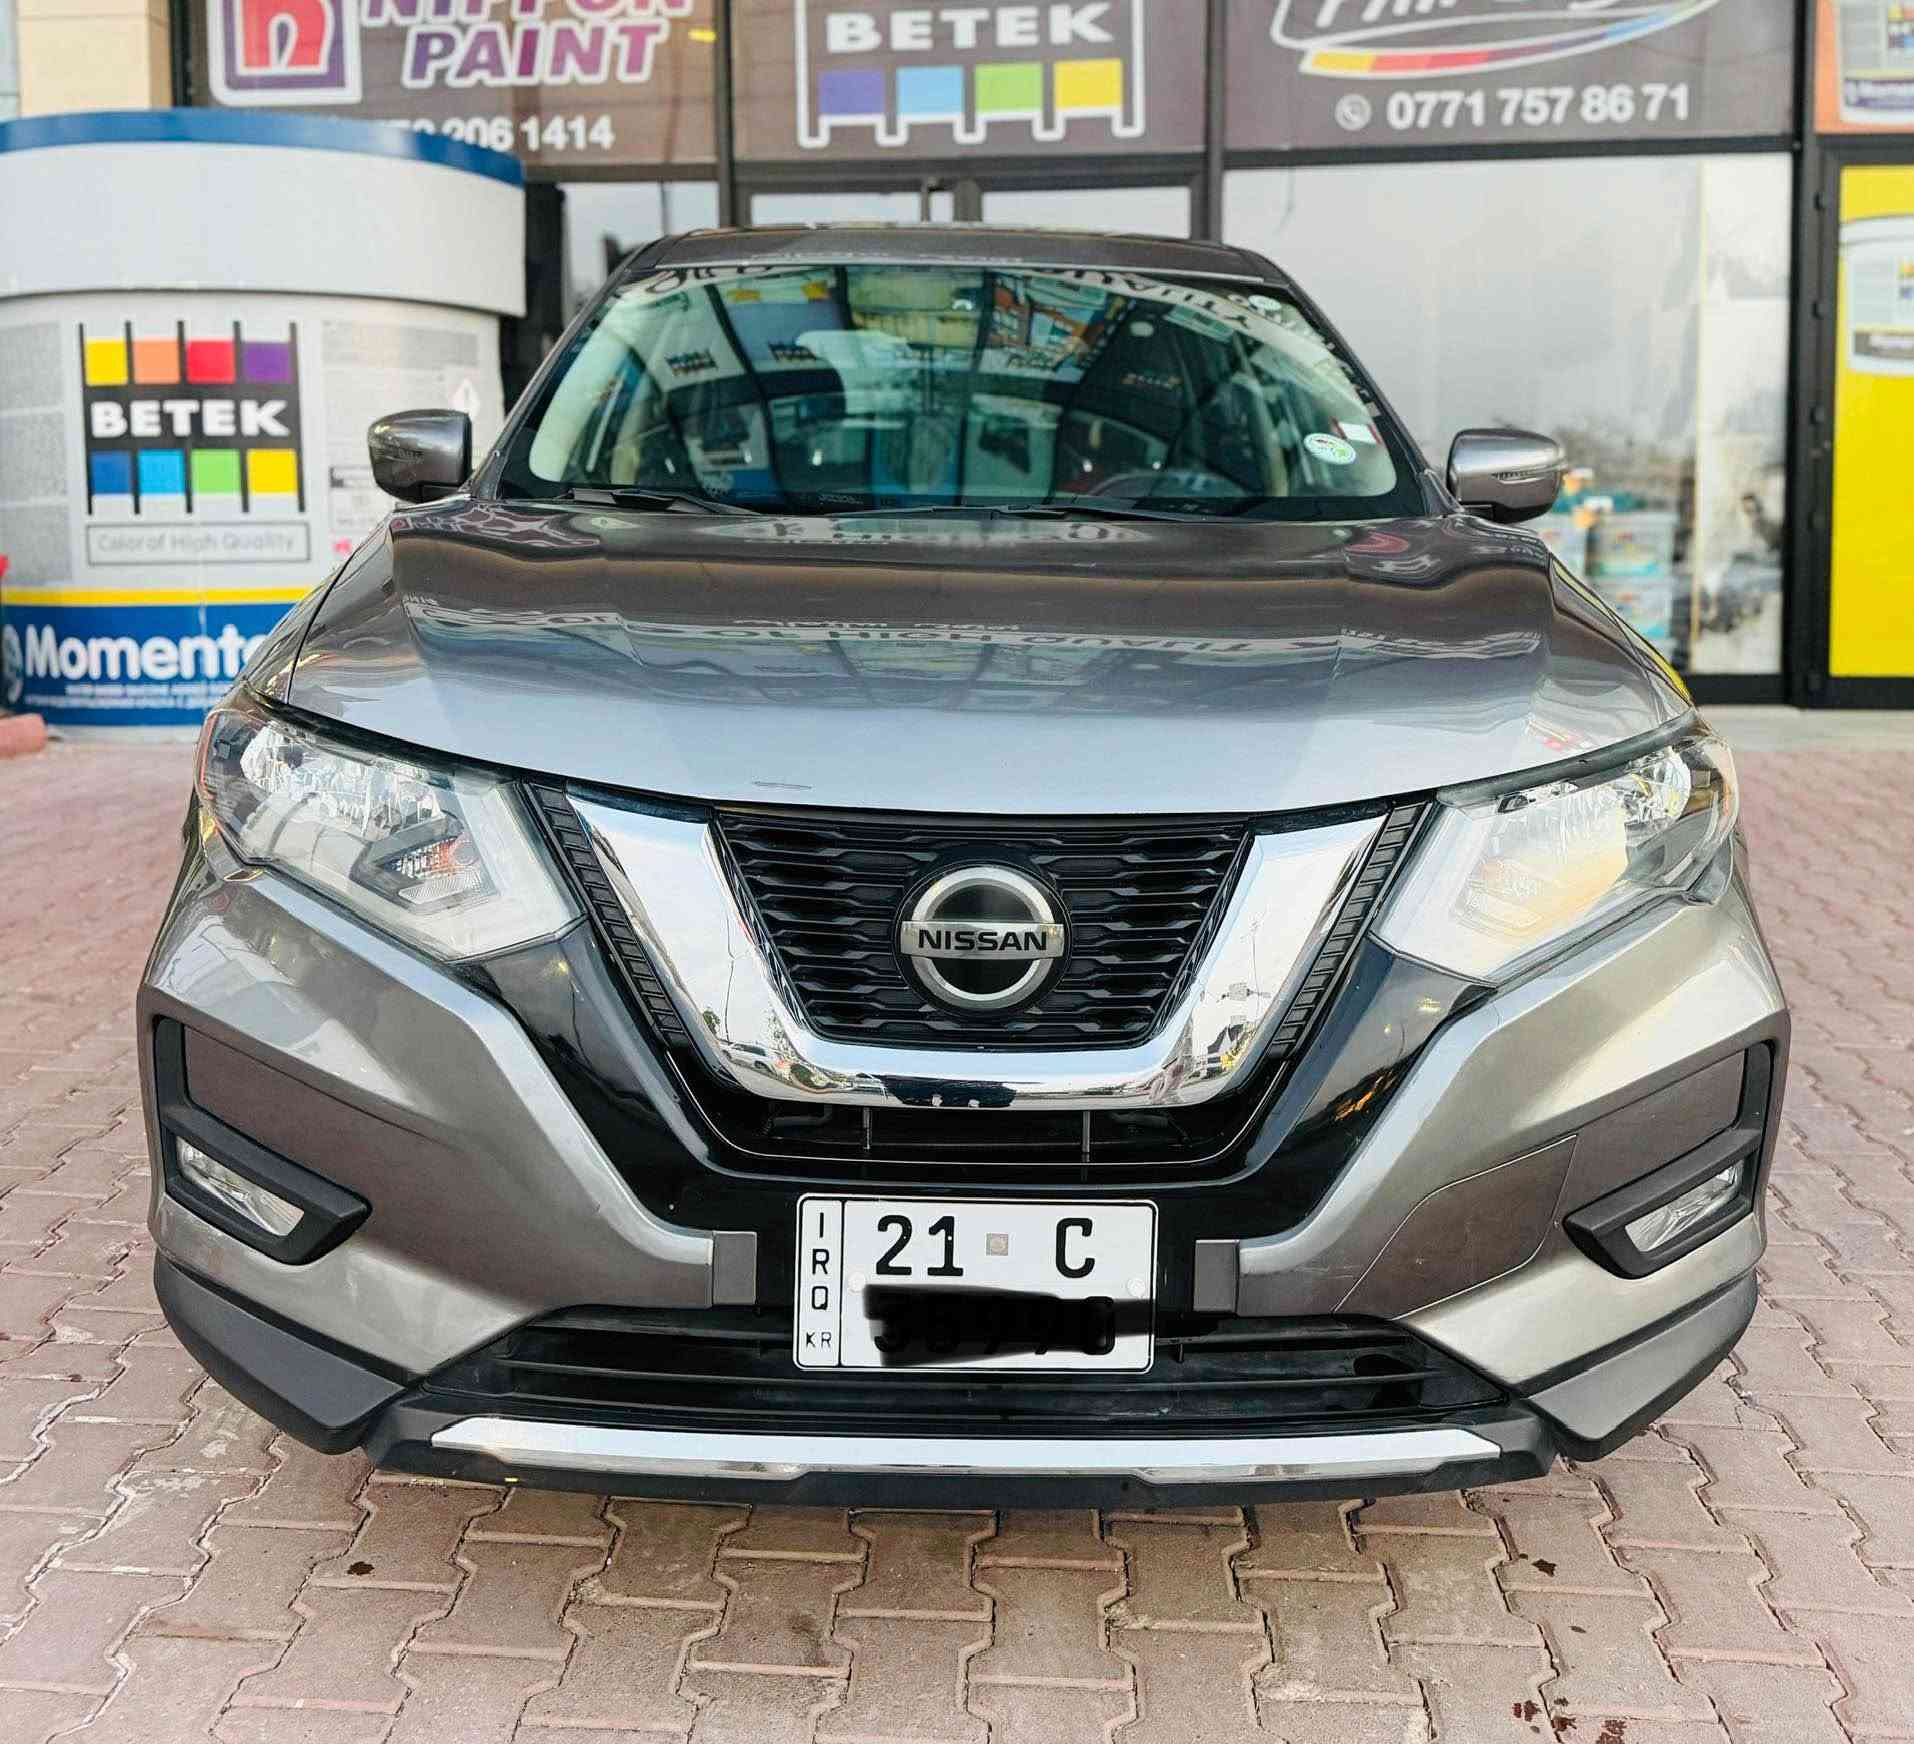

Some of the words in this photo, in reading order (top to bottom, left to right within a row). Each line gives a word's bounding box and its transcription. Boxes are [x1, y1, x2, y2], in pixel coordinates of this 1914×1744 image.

[825, 2, 1115, 53] BETEK
[404, 20, 668, 87] PAINT
[1386, 89, 1485, 131] 0771
[1498, 86, 1574, 127] 757
[1580, 83, 1635, 124] 86
[1641, 81, 1690, 121] 71
[520, 114, 616, 151] 1414
[89, 399, 290, 438] BETEK
[918, 929, 1048, 951] NISSAN
[875, 1214, 964, 1277] 21
[1055, 1217, 1097, 1279] C
[804, 1330, 832, 1349] KR
